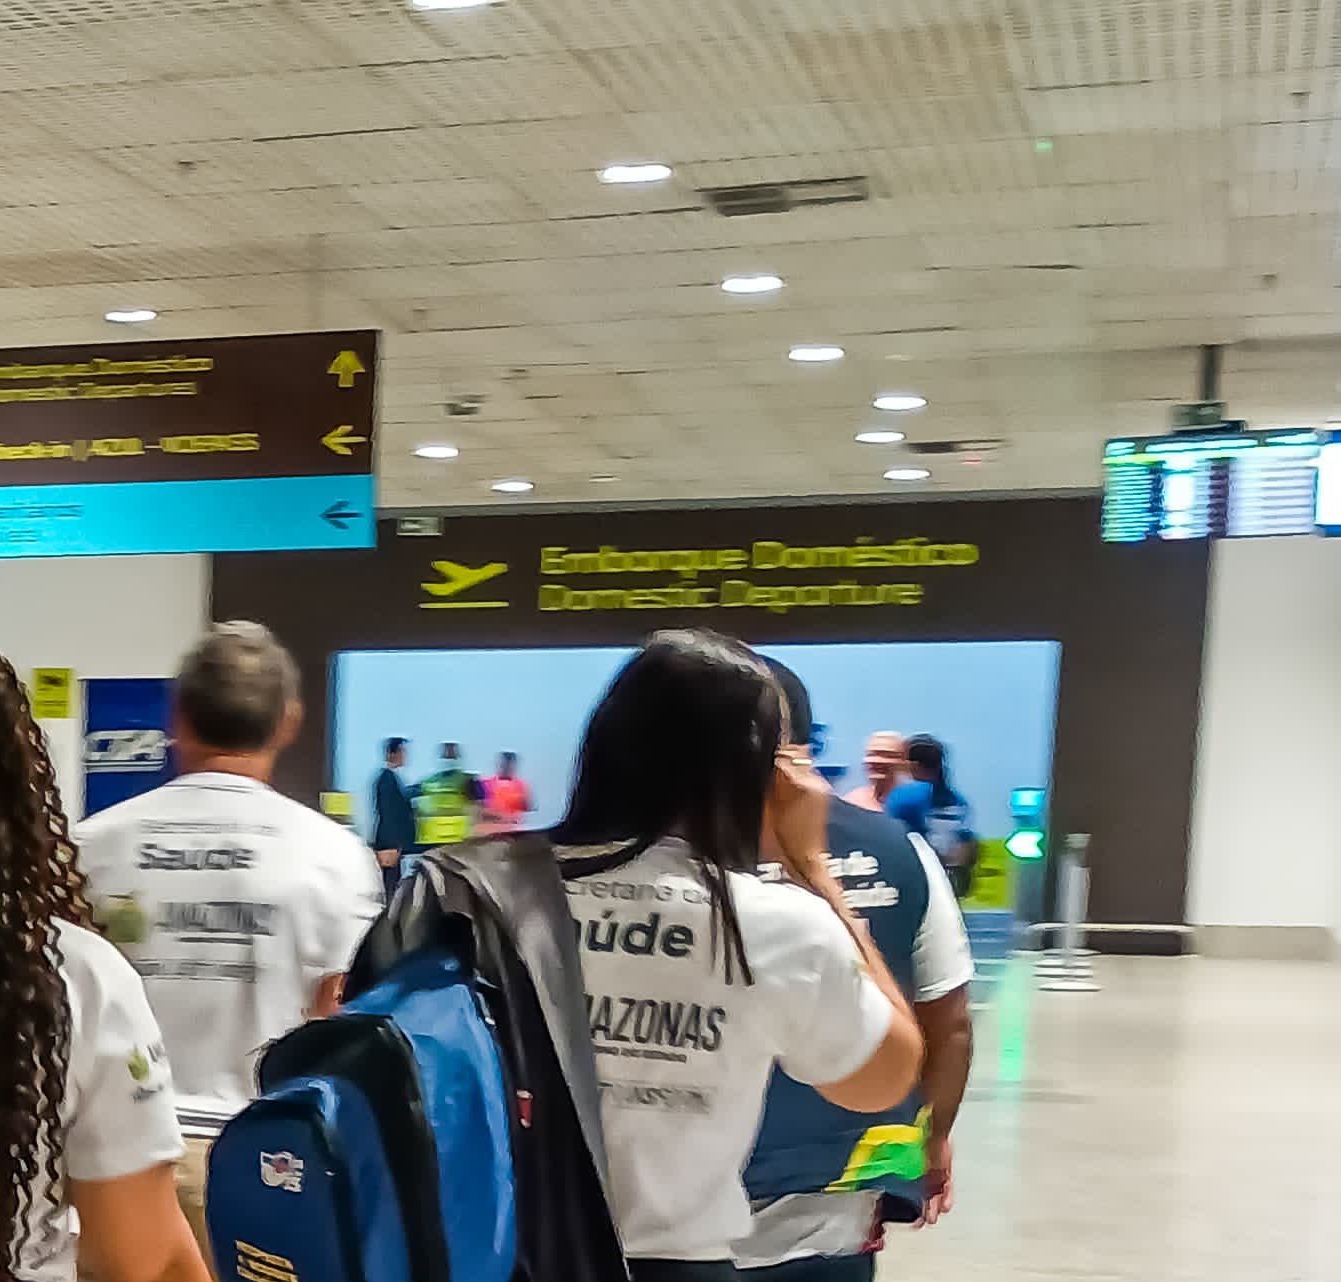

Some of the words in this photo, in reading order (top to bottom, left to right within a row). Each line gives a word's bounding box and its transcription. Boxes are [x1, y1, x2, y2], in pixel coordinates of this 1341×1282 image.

[540, 545, 748, 580] Embarque
[751, 536, 980, 569] Doméstico
[538, 582, 718, 611] Domestic
[571, 909, 694, 957] úde
[583, 994, 726, 1052] AZONAS
